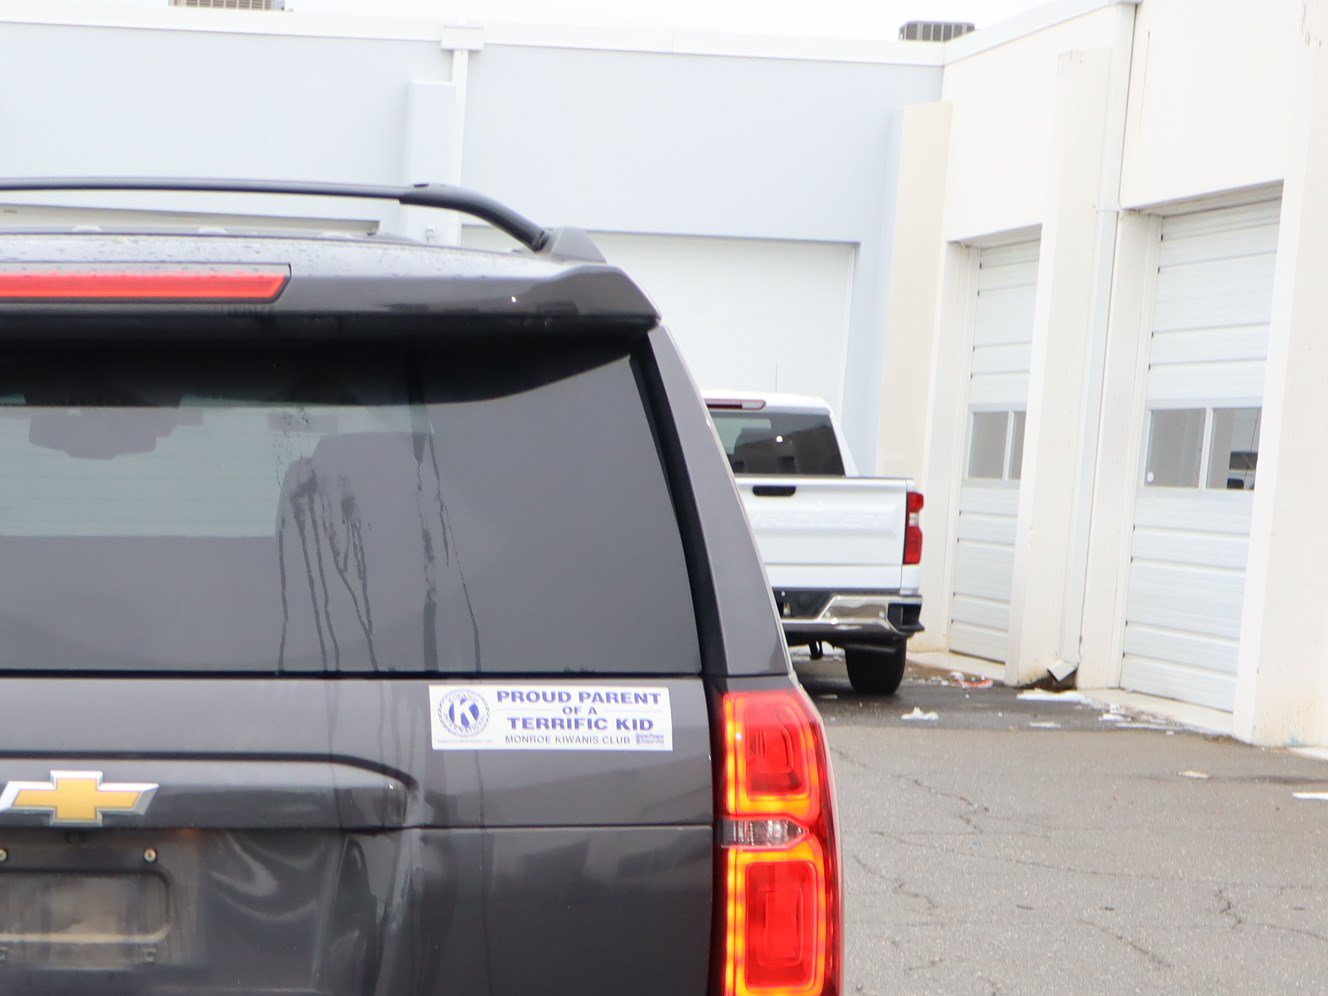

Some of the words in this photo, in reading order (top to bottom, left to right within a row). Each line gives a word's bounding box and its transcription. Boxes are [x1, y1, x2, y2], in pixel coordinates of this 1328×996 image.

[751, 510, 886, 528] VROLET
[496, 690, 572, 704] PROUD
[579, 691, 662, 705] PARENT
[562, 706, 582, 715] OF
[588, 706, 598, 715] A
[507, 717, 608, 731] TERRIFIC
[616, 718, 654, 731] KID
[505, 735, 551, 744] MONROE
[555, 735, 599, 744] KIWANIS
[602, 736, 631, 745] CLUB
